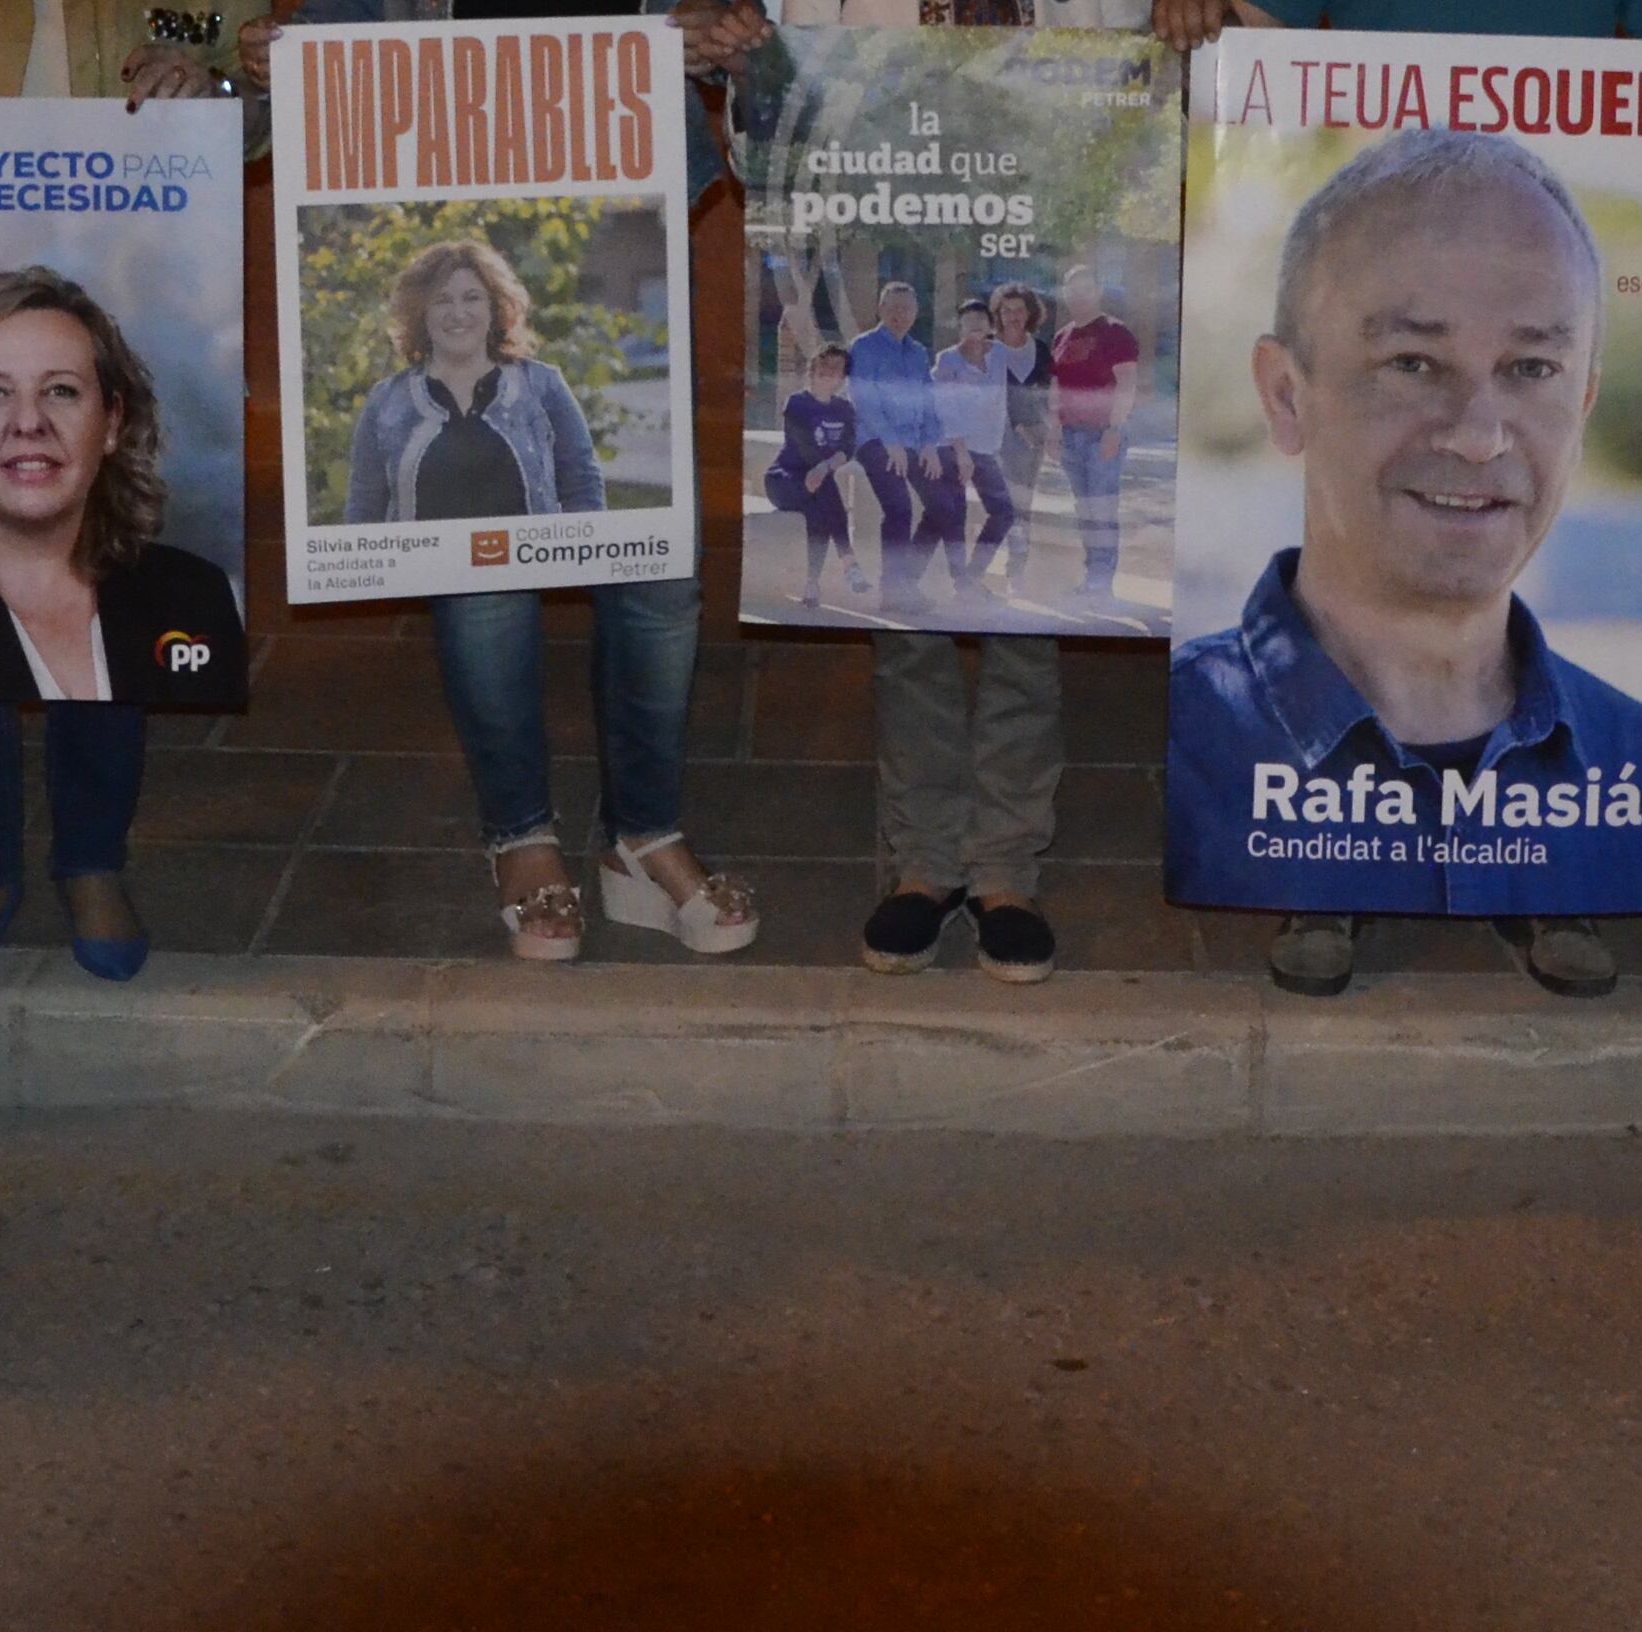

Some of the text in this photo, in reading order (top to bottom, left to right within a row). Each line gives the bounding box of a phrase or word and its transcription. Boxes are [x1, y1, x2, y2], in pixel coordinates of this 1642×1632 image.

[1083, 91, 1152, 107] PETRER
[1291, 60, 1429, 130] TEUA
[302, 30, 654, 192] IMPARABLES
[908, 100, 941, 137] la
[122, 153, 213, 181] PARA
[806, 140, 1019, 183] ciudad que
[789, 182, 1035, 234] podemos
[979, 232, 1036, 259] ser
[307, 537, 354, 554] Silvia
[516, 523, 595, 542] coalició
[516, 535, 670, 565] Compromís
[307, 558, 384, 573] Candidata
[610, 560, 669, 578] Petrer
[307, 577, 322, 591] la
[1251, 761, 1417, 825] Rafa
[1247, 830, 1548, 865] Candidat a l'alcaldia
